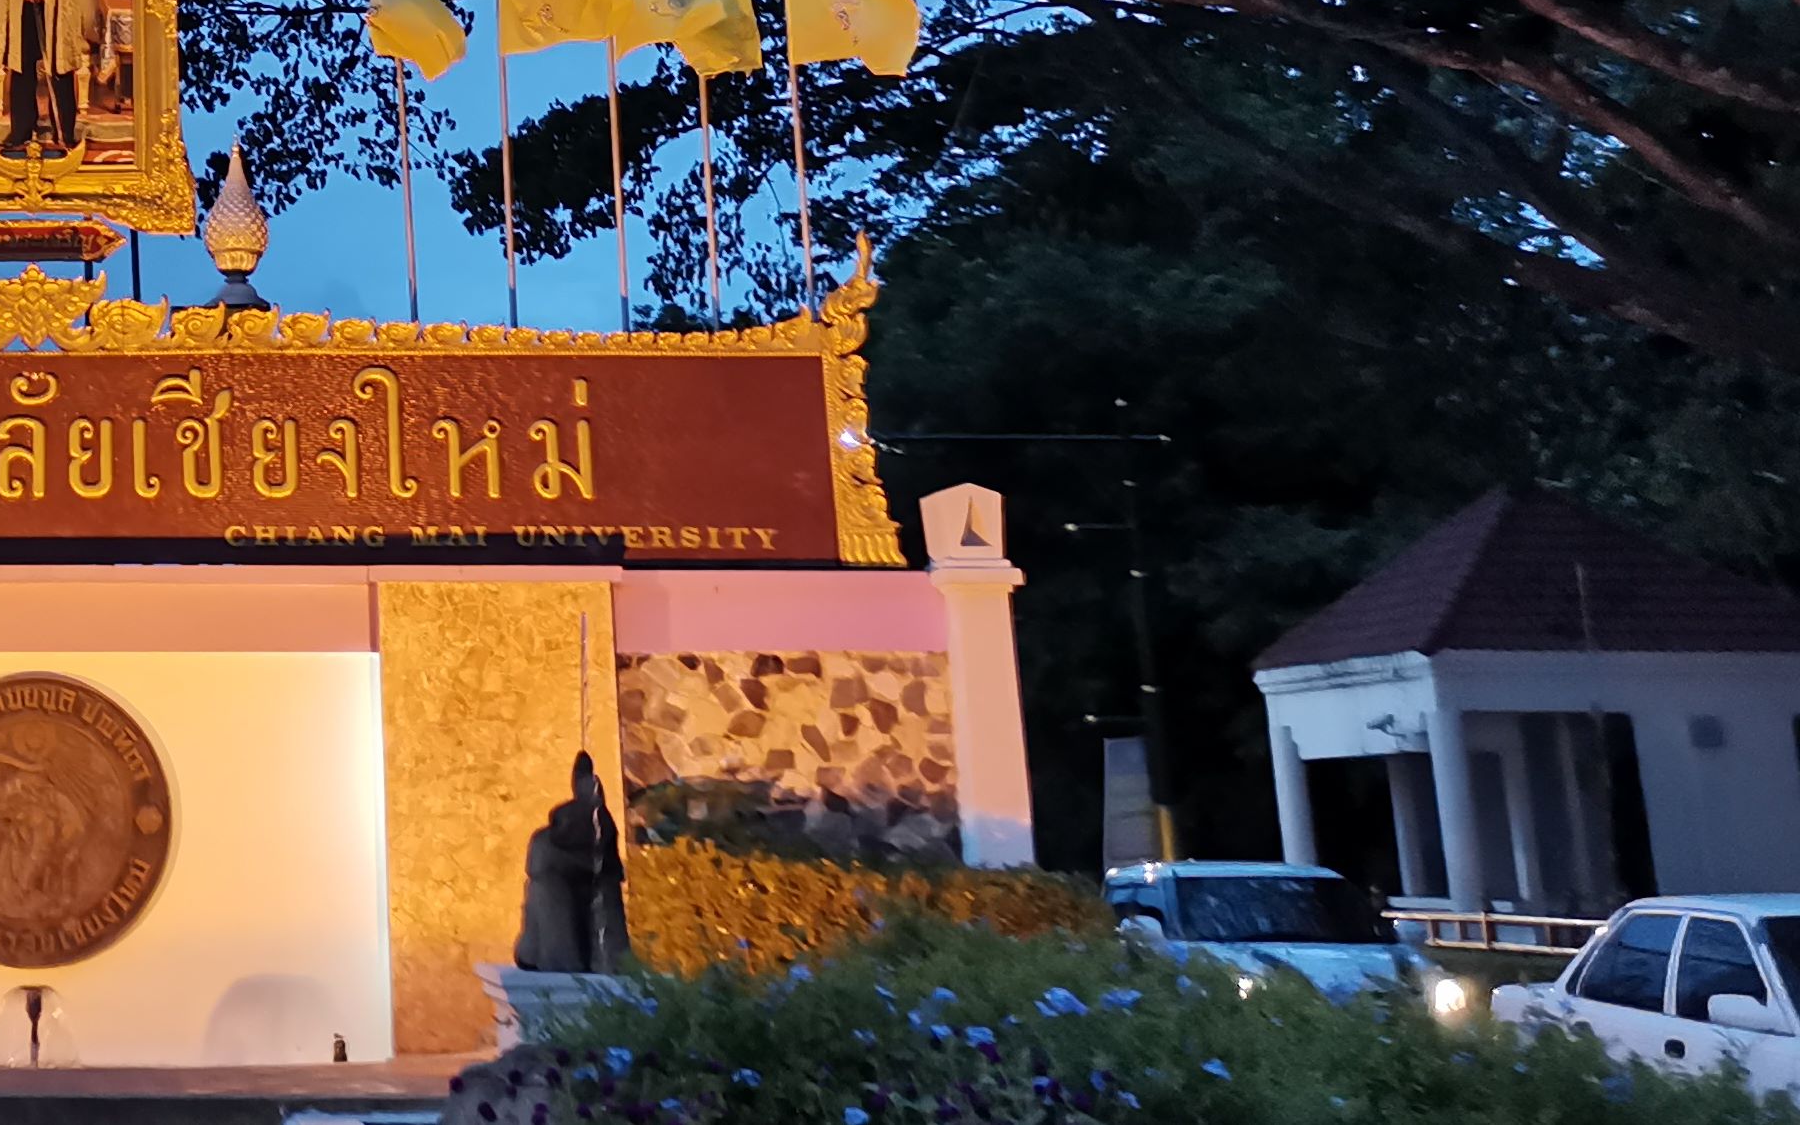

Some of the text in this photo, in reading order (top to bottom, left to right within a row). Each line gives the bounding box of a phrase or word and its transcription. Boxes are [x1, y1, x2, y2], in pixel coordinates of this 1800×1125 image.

[224, 524, 779, 550] CHIANG MAI UNIVERSITY
